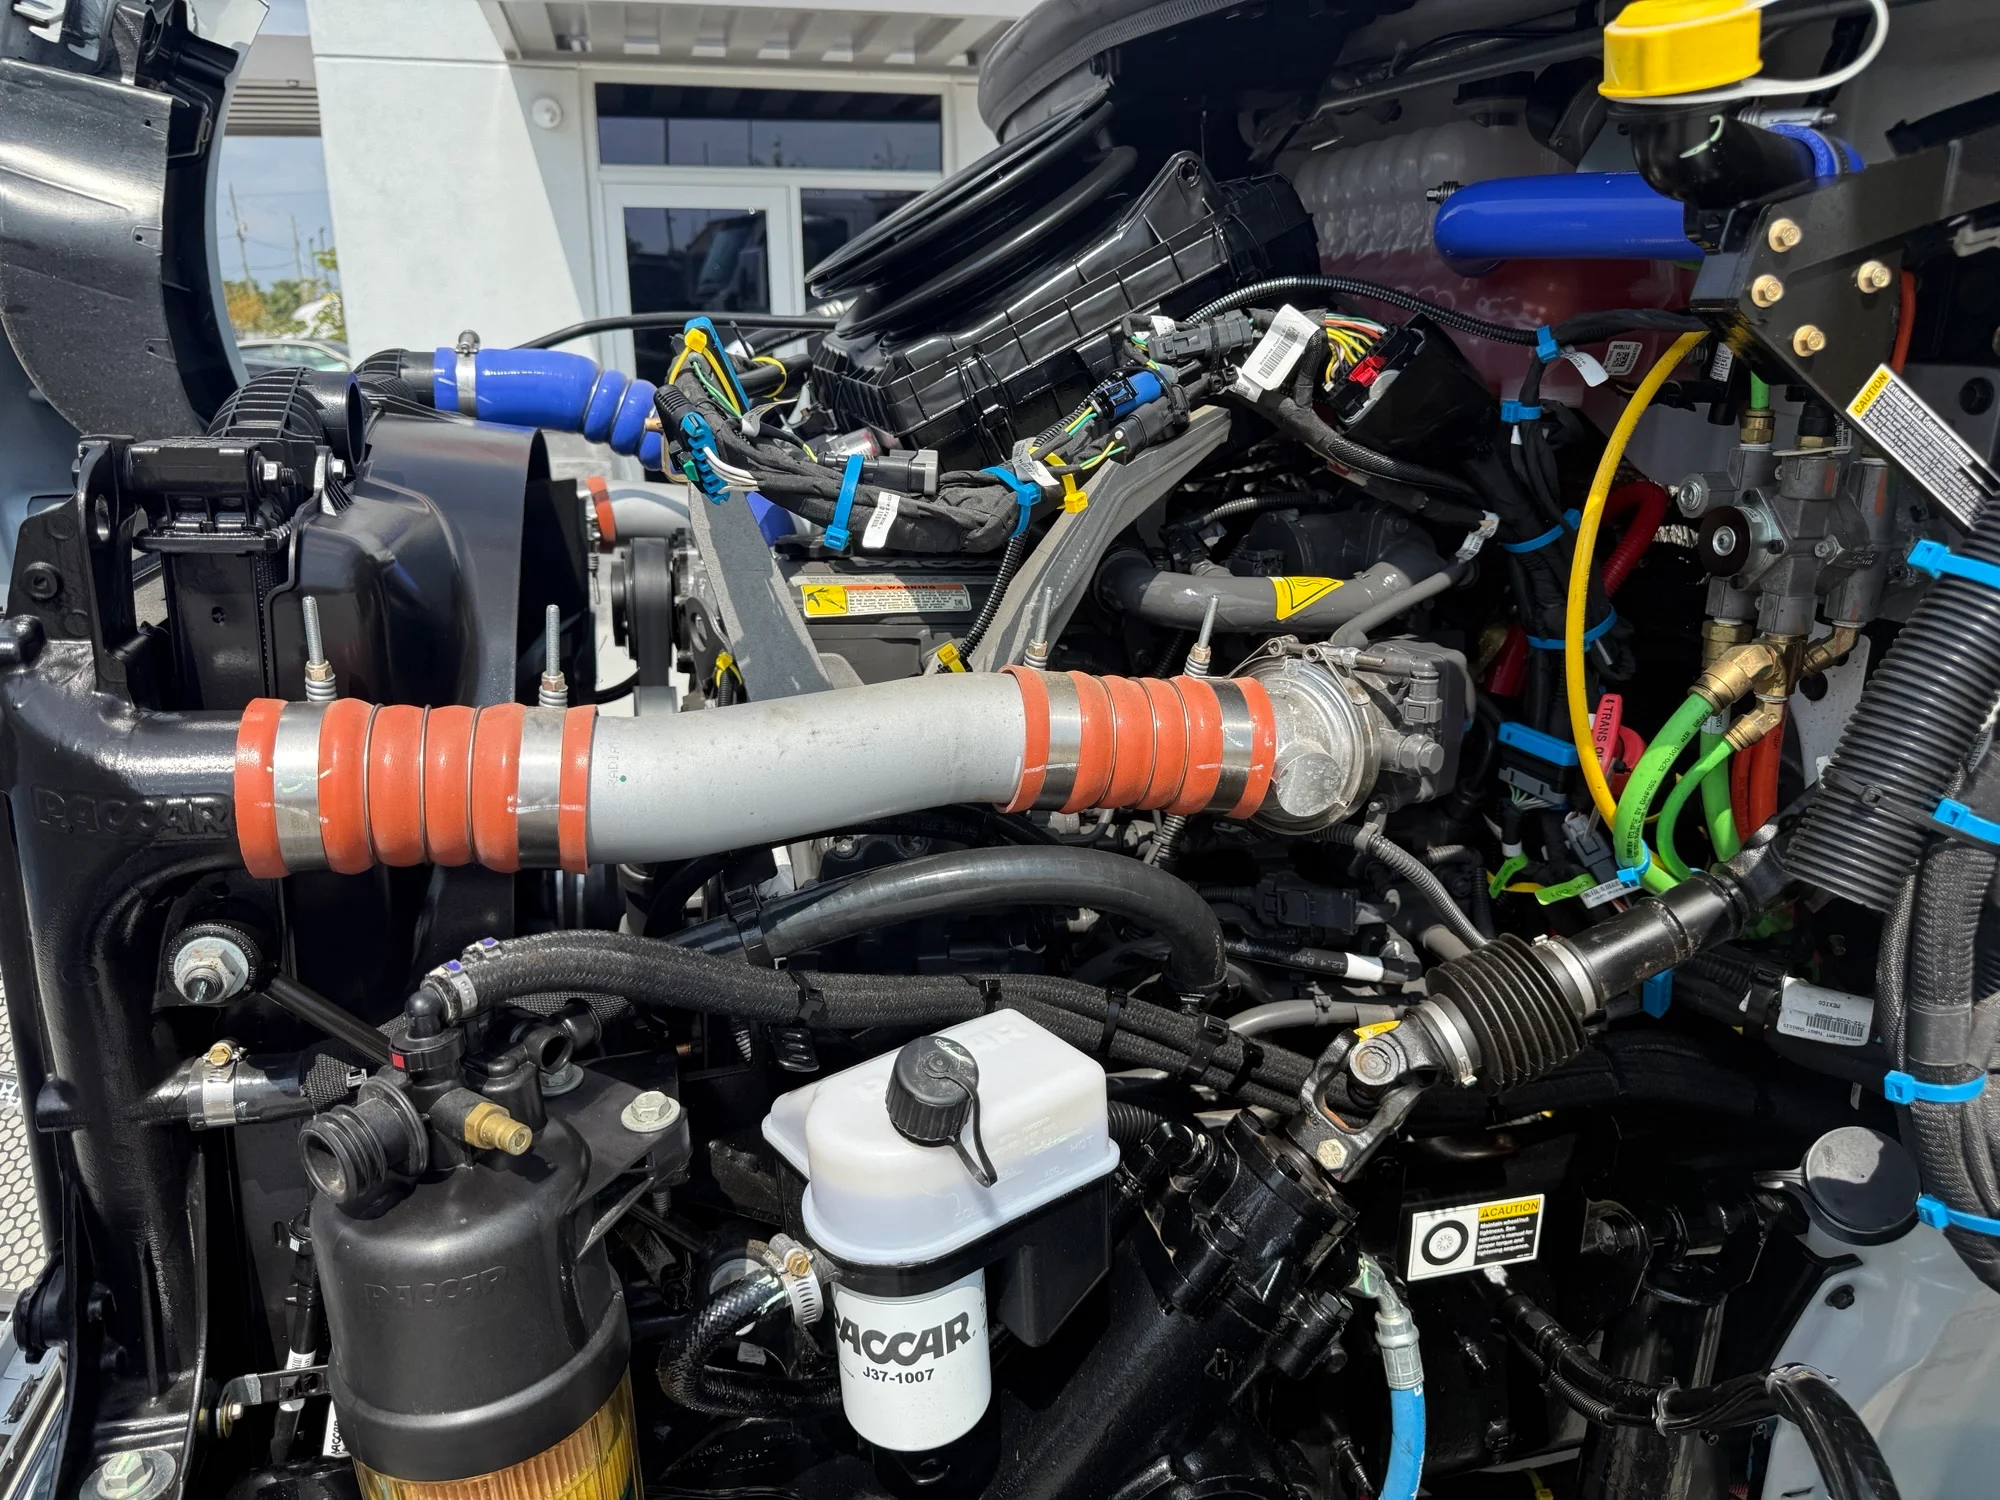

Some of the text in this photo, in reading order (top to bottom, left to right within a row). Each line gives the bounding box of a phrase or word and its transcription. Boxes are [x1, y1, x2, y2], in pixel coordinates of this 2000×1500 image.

[1854, 372, 1887, 414] CAUTION
[1885, 381, 1974, 466] Extended Life Coolant/Antifreeze
[1892, 412, 1908, 428] Extended
[1892, 420, 1901, 429] with
[1597, 706, 1614, 742] TRANS
[1681, 731, 1691, 743] AIR
[1818, 1000, 1841, 1009] MEXICO
[1070, 1134, 1094, 1154] HOT
[1490, 1201, 1538, 1217] CAUTION
[1480, 1221, 1503, 1229] Maintain
[1478, 1234, 1505, 1243] operator's
[1506, 1230, 1525, 1238] manual
[1479, 1228, 1505, 1236] tightness.
[1477, 1243, 1530, 1256] tightening sequence.
[1478, 1242, 1495, 1250] proper
[863, 1366, 935, 1384] J37-1007
